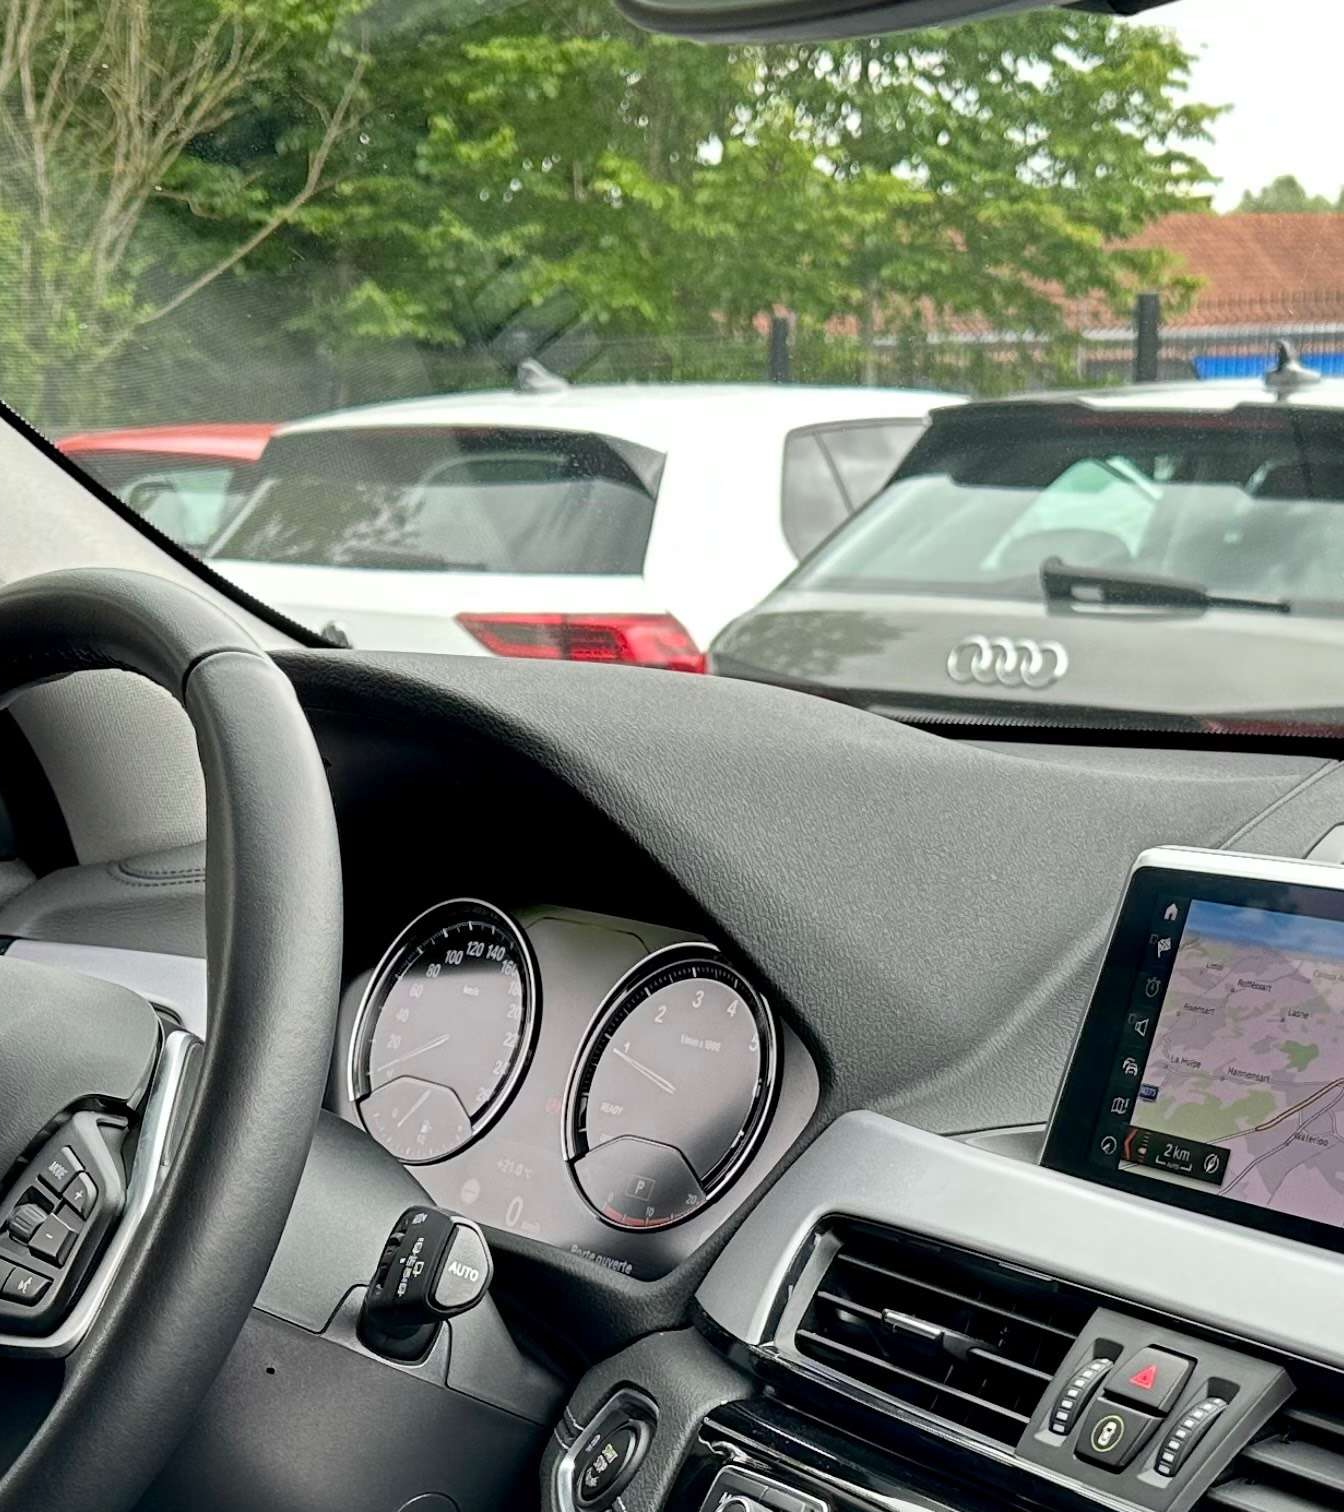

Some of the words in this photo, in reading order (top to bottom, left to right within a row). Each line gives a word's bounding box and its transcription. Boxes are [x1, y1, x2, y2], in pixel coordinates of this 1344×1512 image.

[445, 950, 463, 965] 100
[466, 941, 484, 956] 120
[487, 945, 506, 961] 140
[425, 963, 441, 978] 80
[692, 990, 704, 1008] 3
[726, 999, 739, 1017] 4
[654, 1005, 667, 1023] 2
[1163, 1143, 1173, 1158] 2
[1173, 1145, 1191, 1162] km
[448, 1260, 479, 1282] AUTO
